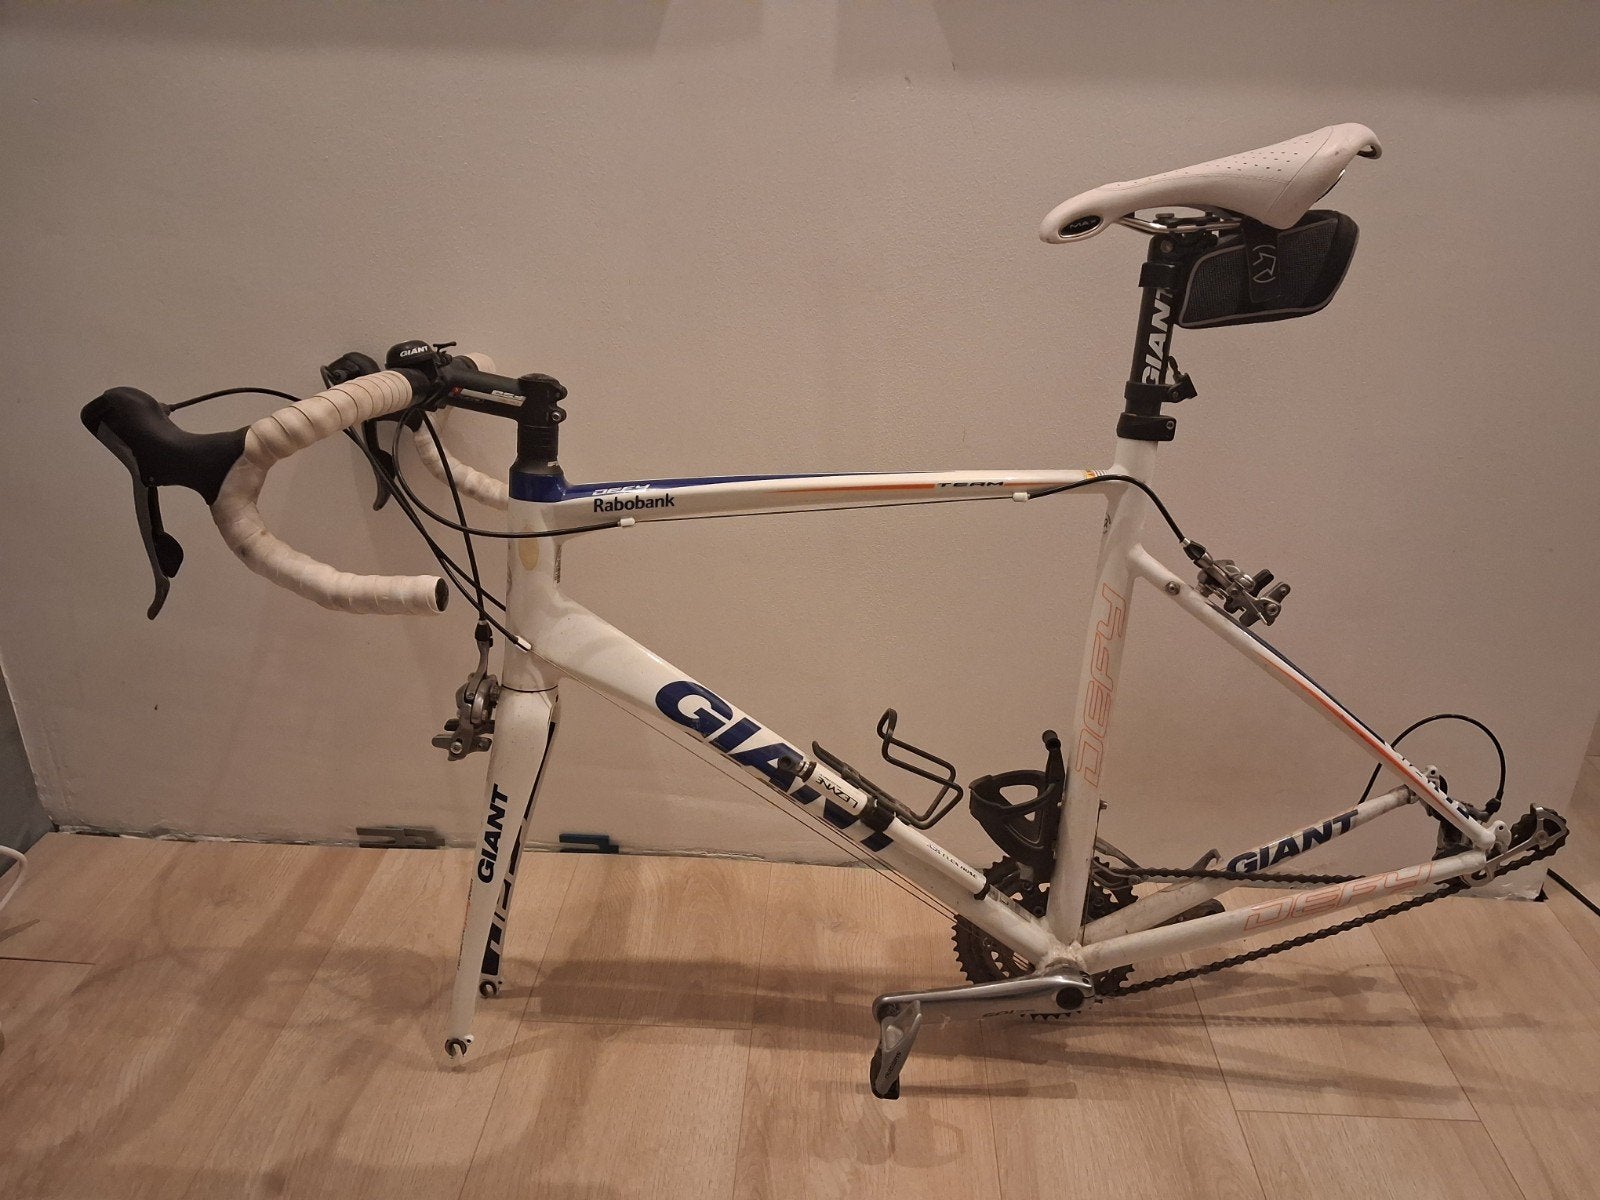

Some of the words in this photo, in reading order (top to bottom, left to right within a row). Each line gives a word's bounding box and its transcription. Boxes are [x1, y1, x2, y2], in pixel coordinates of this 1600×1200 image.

[400, 345, 429, 358] GIANT
[593, 493, 675, 513] Rabobank
[1075, 582, 1127, 788] DEFY
[815, 775, 859, 809] LEZYNE
[477, 783, 508, 884] GIANT
[1225, 809, 1359, 873] GIANT
[1244, 862, 1435, 932] DEFY
